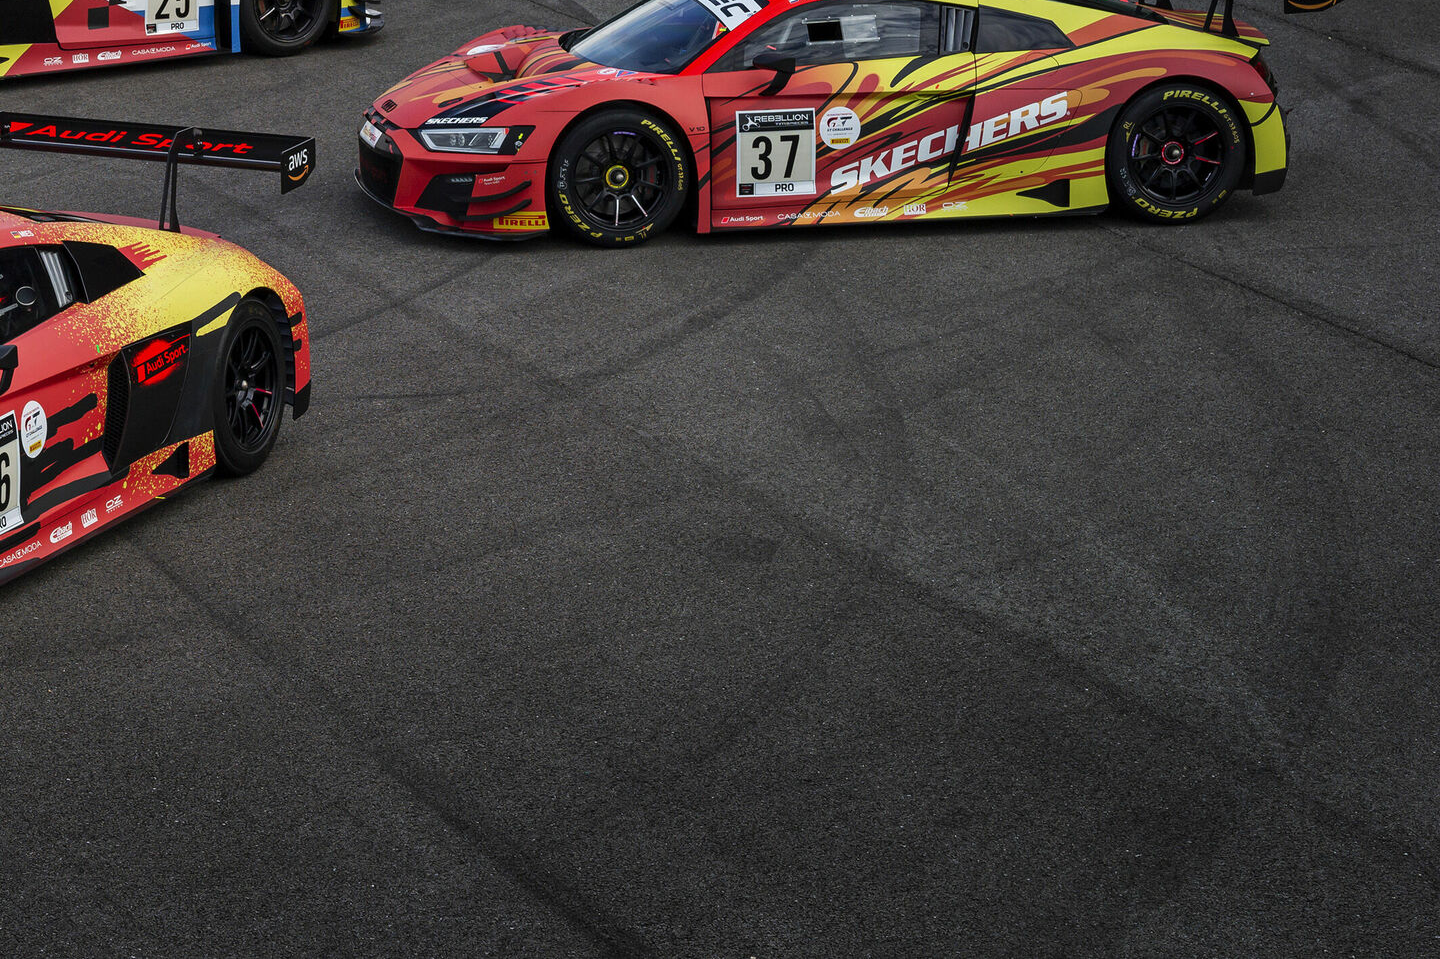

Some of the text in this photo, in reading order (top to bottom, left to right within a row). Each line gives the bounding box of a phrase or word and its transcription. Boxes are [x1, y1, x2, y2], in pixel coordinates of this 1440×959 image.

[171, 22, 185, 30] PRO
[1163, 90, 1227, 115] PIRELLI
[425, 116, 489, 125] SKECHERS
[25, 125, 127, 143] Audi
[641, 119, 681, 162] PIRELLI
[830, 91, 1070, 195] SKECHERS
[288, 148, 309, 172] aws
[750, 134, 800, 181] 37
[774, 183, 794, 193] PRO
[498, 215, 546, 227] PIRELLI
[746, 214, 764, 222] Sport
[777, 210, 841, 221] CASA MODA
[20, 230, 35, 238] MIES
[146, 344, 186, 375] Audi Sport
[21, 540, 43, 554] MODA
